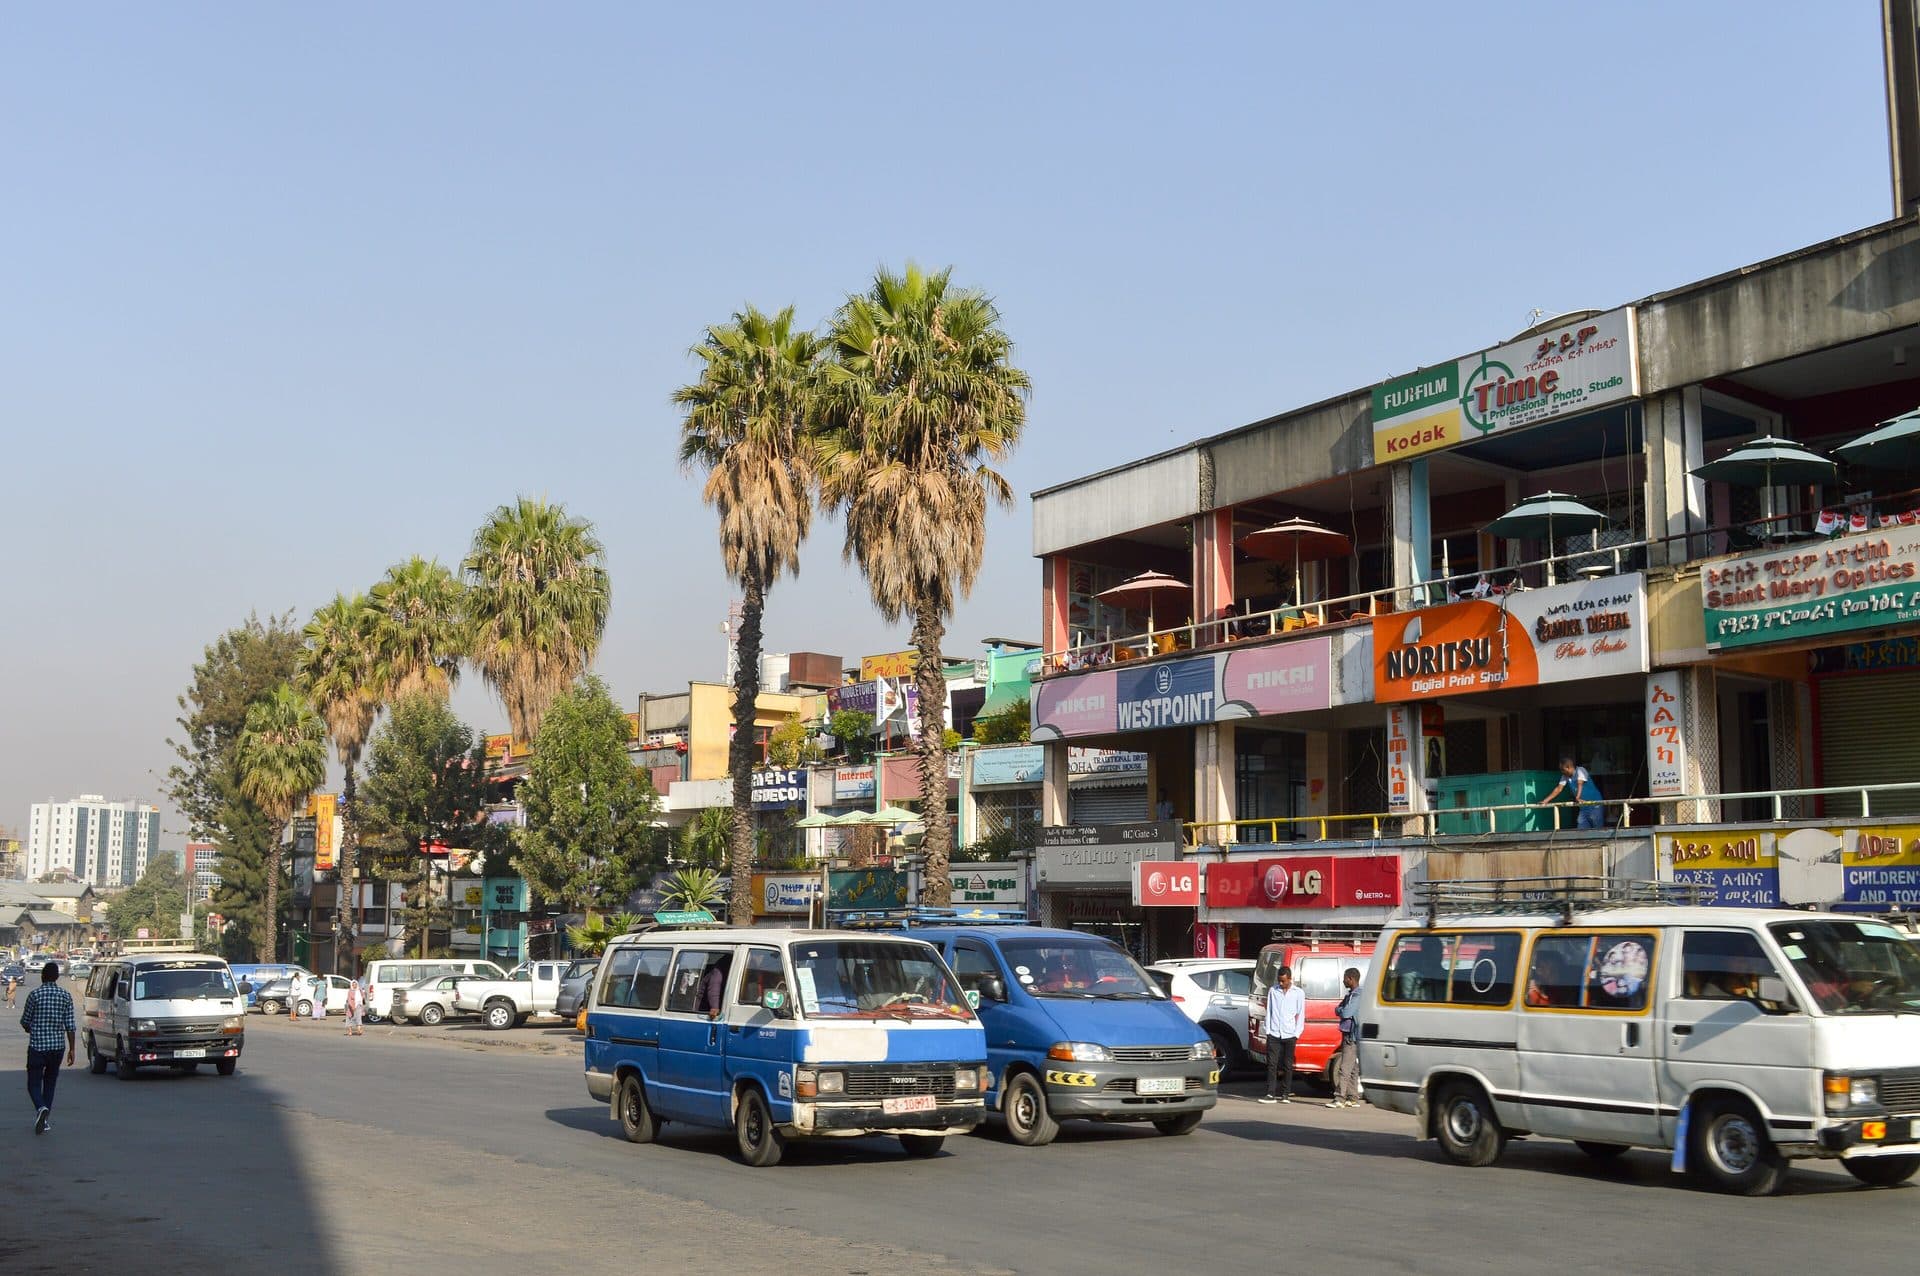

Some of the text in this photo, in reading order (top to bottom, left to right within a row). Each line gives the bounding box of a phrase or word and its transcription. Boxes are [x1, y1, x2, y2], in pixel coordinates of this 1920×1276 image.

[1383, 377, 1448, 410] FUJIFILM
[1474, 369, 1559, 413] Time
[1490, 395, 1549, 420] Professional
[1552, 386, 1583, 403] Photo
[1588, 375, 1623, 393] Studio
[1386, 424, 1446, 454] Kodak
[1708, 561, 1759, 587] ቅድስት
[1764, 552, 1819, 576] ማርያም
[1707, 560, 1915, 609] Saint Mary Optics
[1387, 637, 1491, 680] NORITSU
[1555, 635, 1628, 660] Photo Studio
[1411, 677, 1445, 694] Digital
[1449, 673, 1475, 687] Print
[1118, 691, 1214, 729] WESTPOINT
[837, 770, 873, 781] Internet
[1068, 760, 1093, 773] OHA
[1858, 833, 1902, 860] ADEI
[1171, 875, 1192, 892] LG
[1292, 869, 1322, 895] LG
[1849, 870, 1920, 885] CHILDREN'
[1859, 889, 1887, 903] AND
